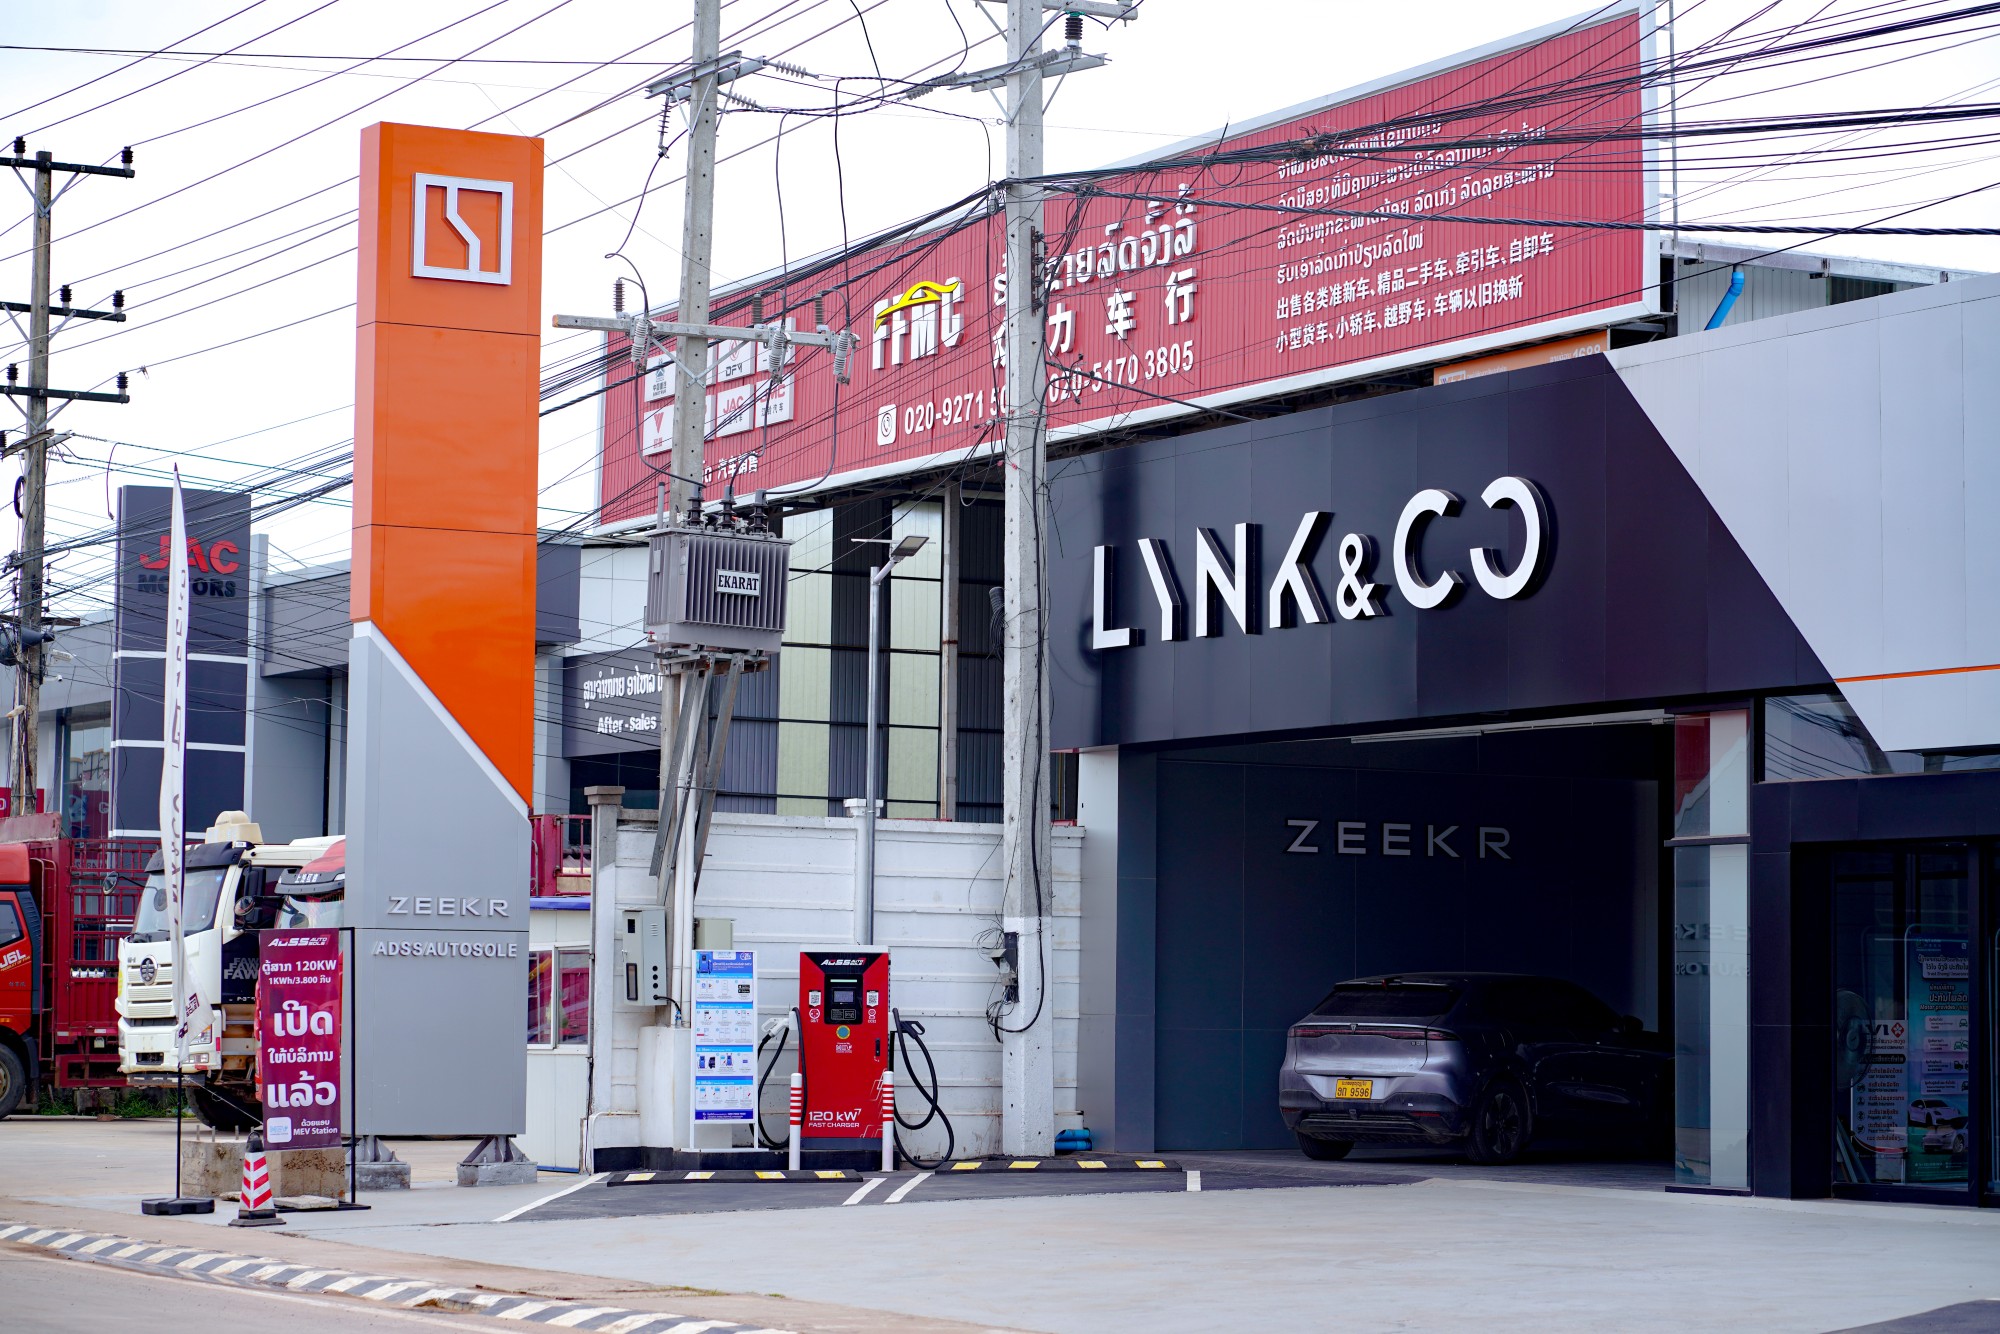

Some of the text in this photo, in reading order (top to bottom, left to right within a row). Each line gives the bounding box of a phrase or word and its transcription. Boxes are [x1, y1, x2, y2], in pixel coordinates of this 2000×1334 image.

[904, 390, 984, 435] 020-9271
[1049, 354, 1139, 404] 020-5170
[1144, 340, 1195, 380] 3805
[723, 395, 744, 414] JAC
[139, 535, 240, 575] JAC
[138, 574, 236, 598] MOORS
[718, 574, 759, 591] EKARAT
[1287, 819, 1512, 860] ZEEKR
[388, 896, 510, 918] ZEEKR
[224, 968, 259, 980] FAW
[295, 960, 337, 972] 120KW
[267, 1070, 337, 1108] ແລ້ວ
[1350, 1087, 1370, 1098] 9596
[808, 1111, 858, 1121] 120 kW
[293, 1126, 338, 1136] MEV Station
